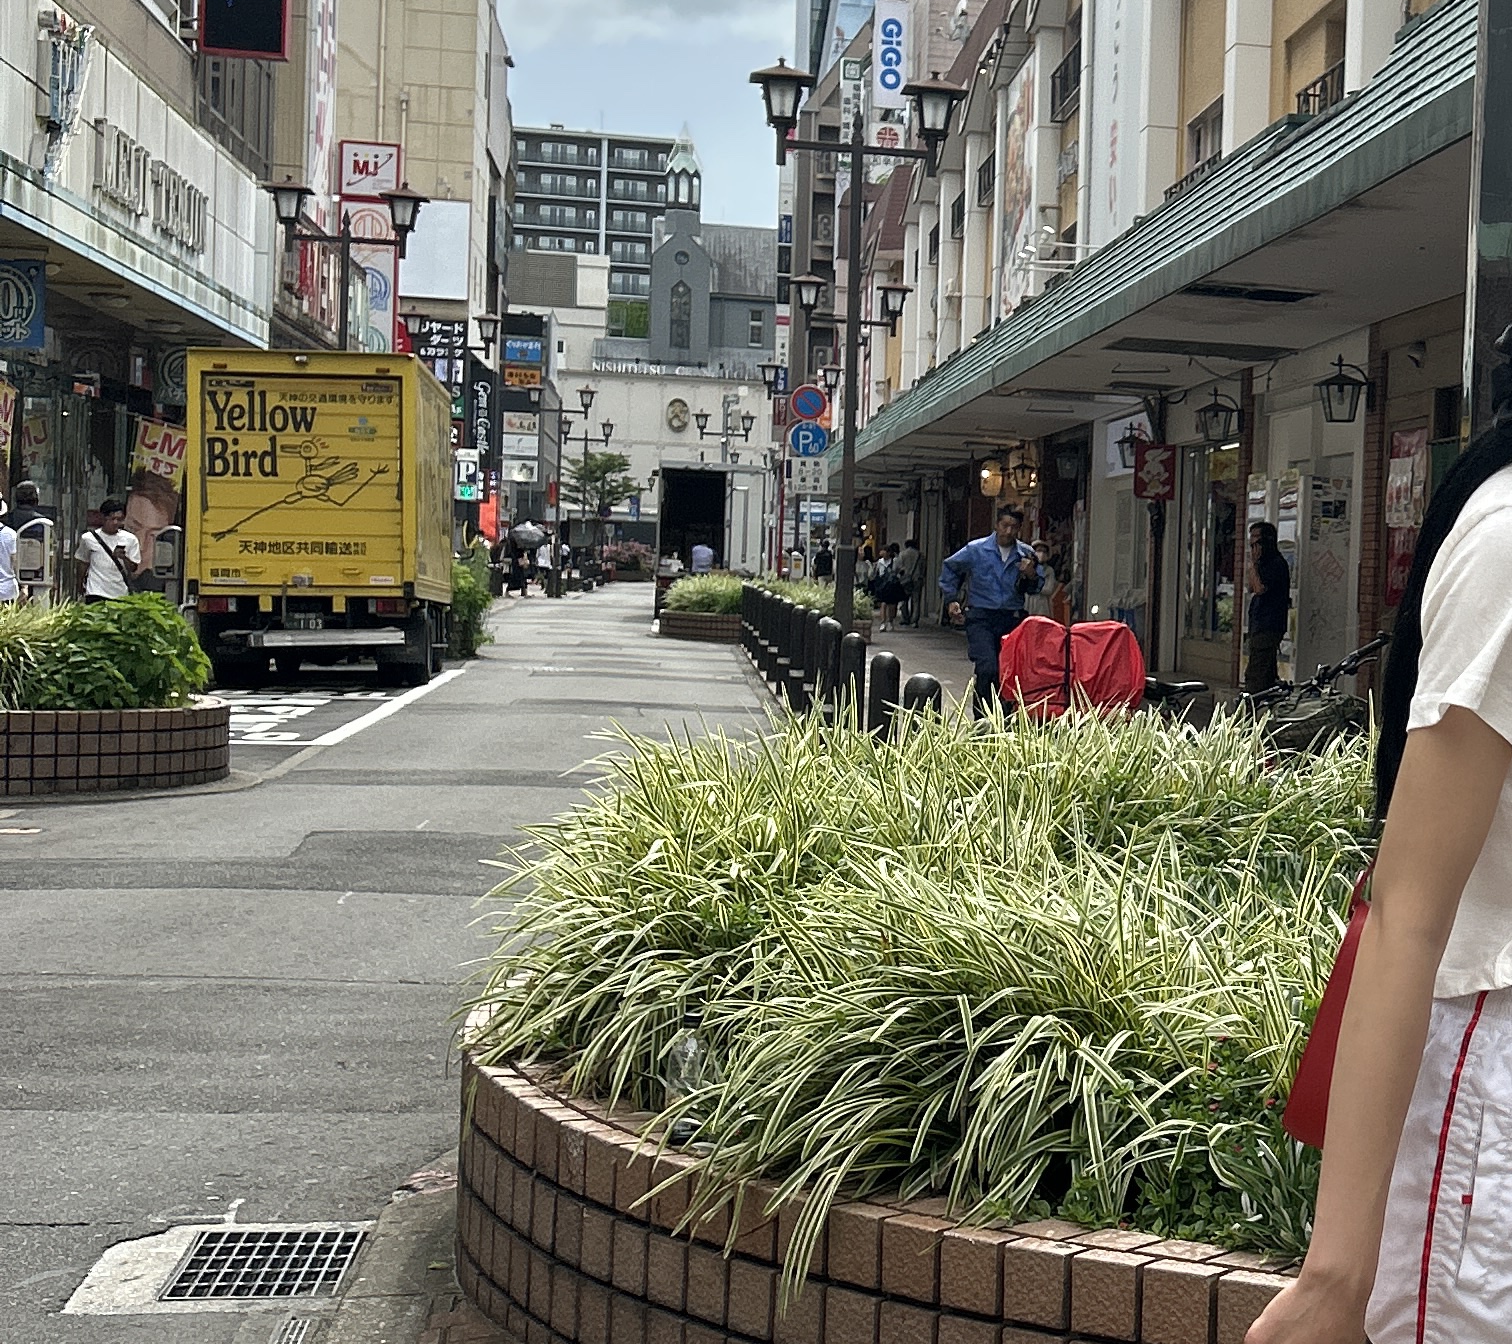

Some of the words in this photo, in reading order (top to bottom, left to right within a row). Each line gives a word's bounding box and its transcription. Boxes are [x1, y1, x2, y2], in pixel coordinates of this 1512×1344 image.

[880, 18, 902, 90] GiGO
[207, 389, 317, 433] Yellow
[207, 435, 279, 477] Bird
